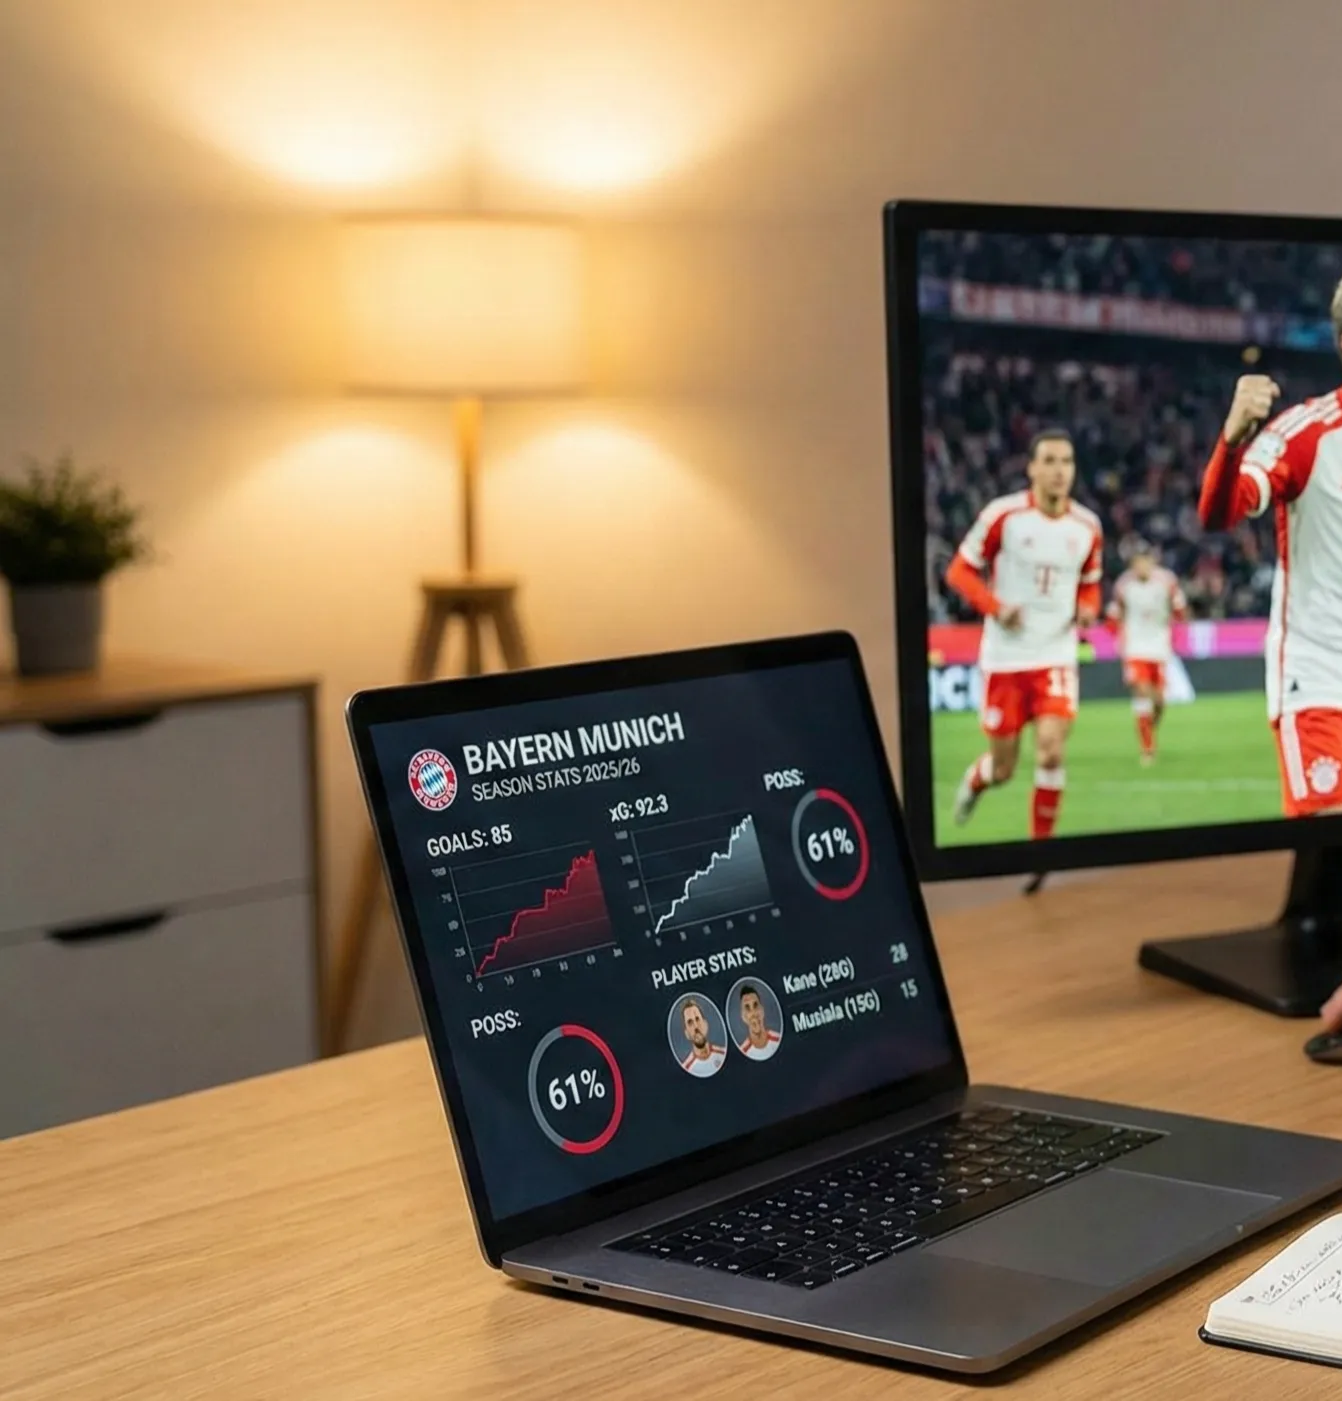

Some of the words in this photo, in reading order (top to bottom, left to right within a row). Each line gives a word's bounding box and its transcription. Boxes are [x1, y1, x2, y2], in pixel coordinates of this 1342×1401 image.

[462, 730, 575, 775] BAYERN
[577, 712, 685, 755] MUNICH
[471, 775, 537, 802] SEASON
[536, 766, 582, 791] STATS
[584, 757, 641, 783] 2025/26
[763, 768, 805, 791] POSS:
[609, 802, 634, 822] xG:
[636, 794, 669, 817] 92.3
[426, 829, 489, 857] GOALS:
[491, 824, 513, 845] 85
[807, 827, 854, 862] 61%
[651, 958, 711, 989] PLAYER
[708, 946, 757, 973] STATS:
[782, 972, 817, 994] Kane
[818, 957, 855, 989] (28G)
[889, 943, 909, 965] 28
[471, 1009, 522, 1039] POSS:
[791, 1002, 844, 1032] Musiala
[844, 989, 881, 1020] (15G)
[900, 979, 919, 999] 15
[548, 1069, 606, 1111] 61%
